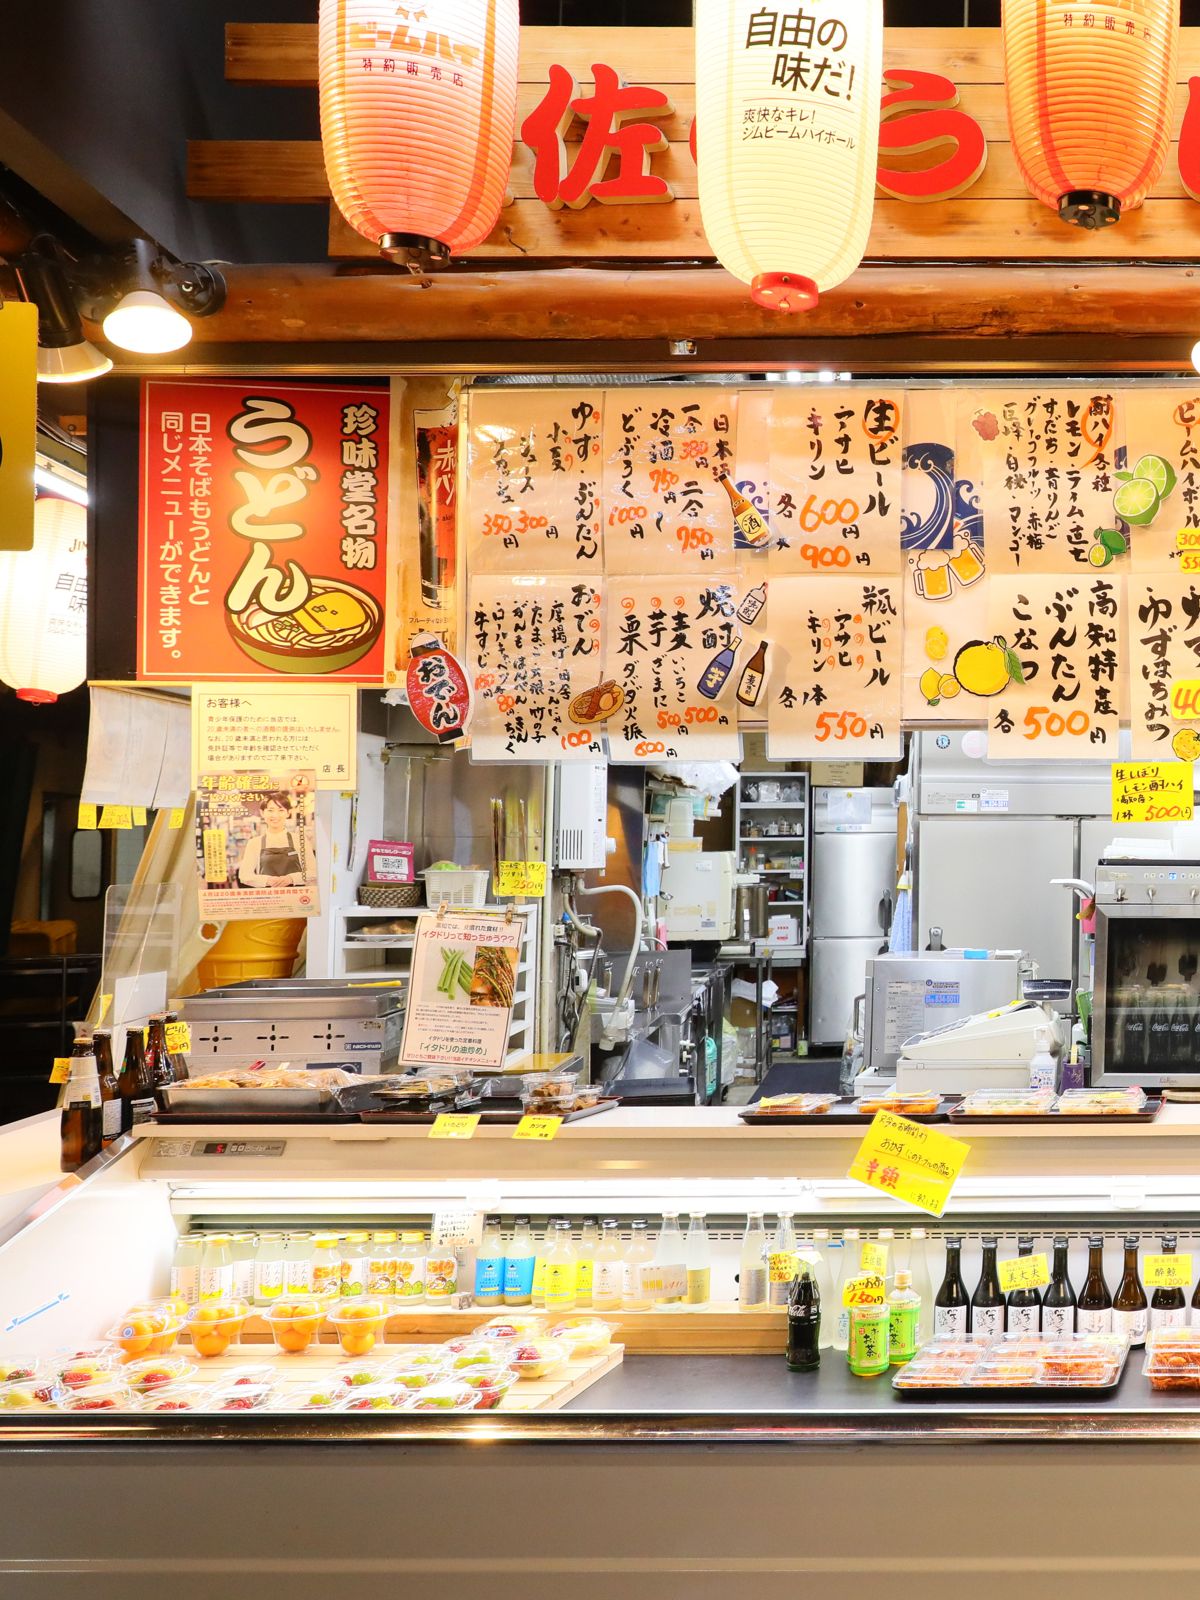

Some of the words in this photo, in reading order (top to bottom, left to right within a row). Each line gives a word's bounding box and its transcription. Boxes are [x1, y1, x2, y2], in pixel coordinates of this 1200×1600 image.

[744, 6, 848, 52] 自由の
[362, 57, 464, 89] 特約販売店
[769, 50, 856, 102] 味だ!
[741, 124, 857, 151] ジムビームハイボール
[742, 106, 816, 127] 爽快なキレ!
[618, 406, 643, 499] どぶろく
[862, 399, 900, 517] 生ビール
[188, 413, 213, 606] 日本そばもうどんと
[225, 396, 319, 615] うどん
[341, 403, 377, 570] 珍味堂名物
[159, 411, 184, 660] 同じメニューができます。
[742, 514, 762, 535] 酒
[800, 543, 872, 570] 900円
[571, 583, 595, 657] おでん
[696, 586, 735, 650] 焼酎
[861, 585, 897, 689] 瓶ビール
[1011, 594, 1040, 682] こなつ
[1045, 587, 1081, 703] ぶんたん
[1084, 580, 1118, 717] 高知特産
[1138, 587, 1178, 743] ゆずはちみつ
[206, 698, 252, 709] お客様へ
[416, 655, 461, 730] おでん
[814, 709, 885, 743] 550円
[1022, 706, 1107, 744] 500円
[1116, 767, 1160, 782] 生しぼり
[866, 1157, 900, 1190] 半額
[1006, 1268, 1041, 1284] 美丈夫
[1154, 1266, 1177, 1278] 酔鯨
